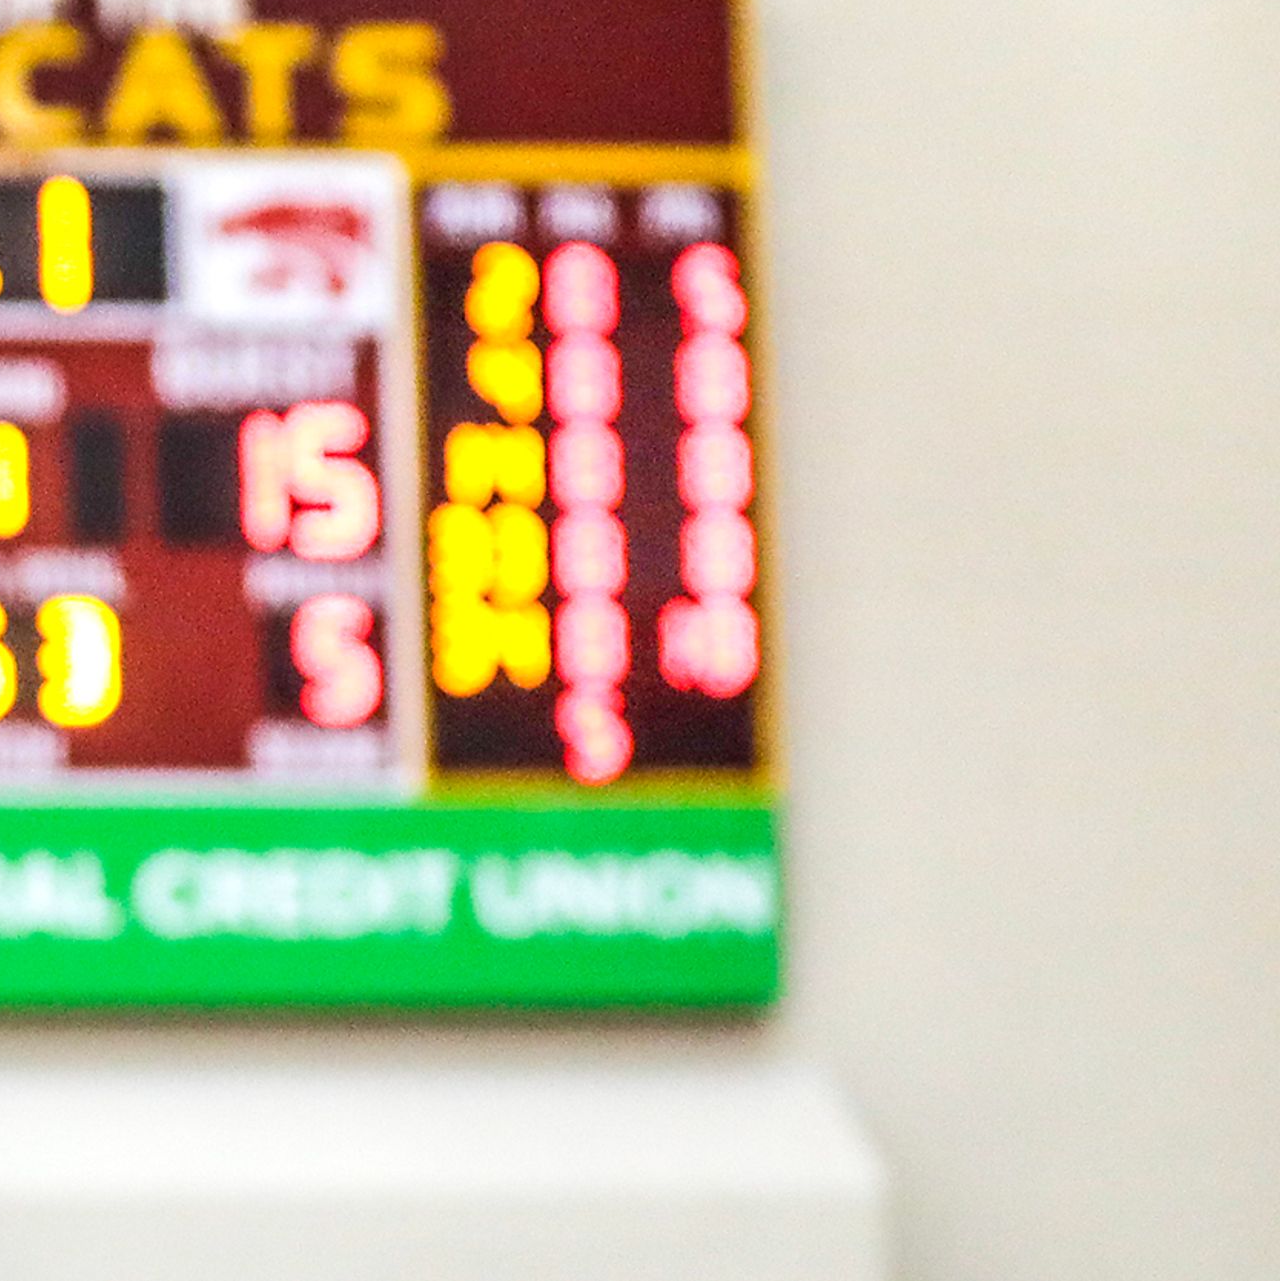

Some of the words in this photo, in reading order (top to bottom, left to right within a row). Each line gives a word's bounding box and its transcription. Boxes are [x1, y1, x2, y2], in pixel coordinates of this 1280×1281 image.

[240, 400, 380, 562] 15
[290, 593, 382, 728] 5
[130, 848, 458, 941] CREDIT
[471, 850, 778, 940] UNION
